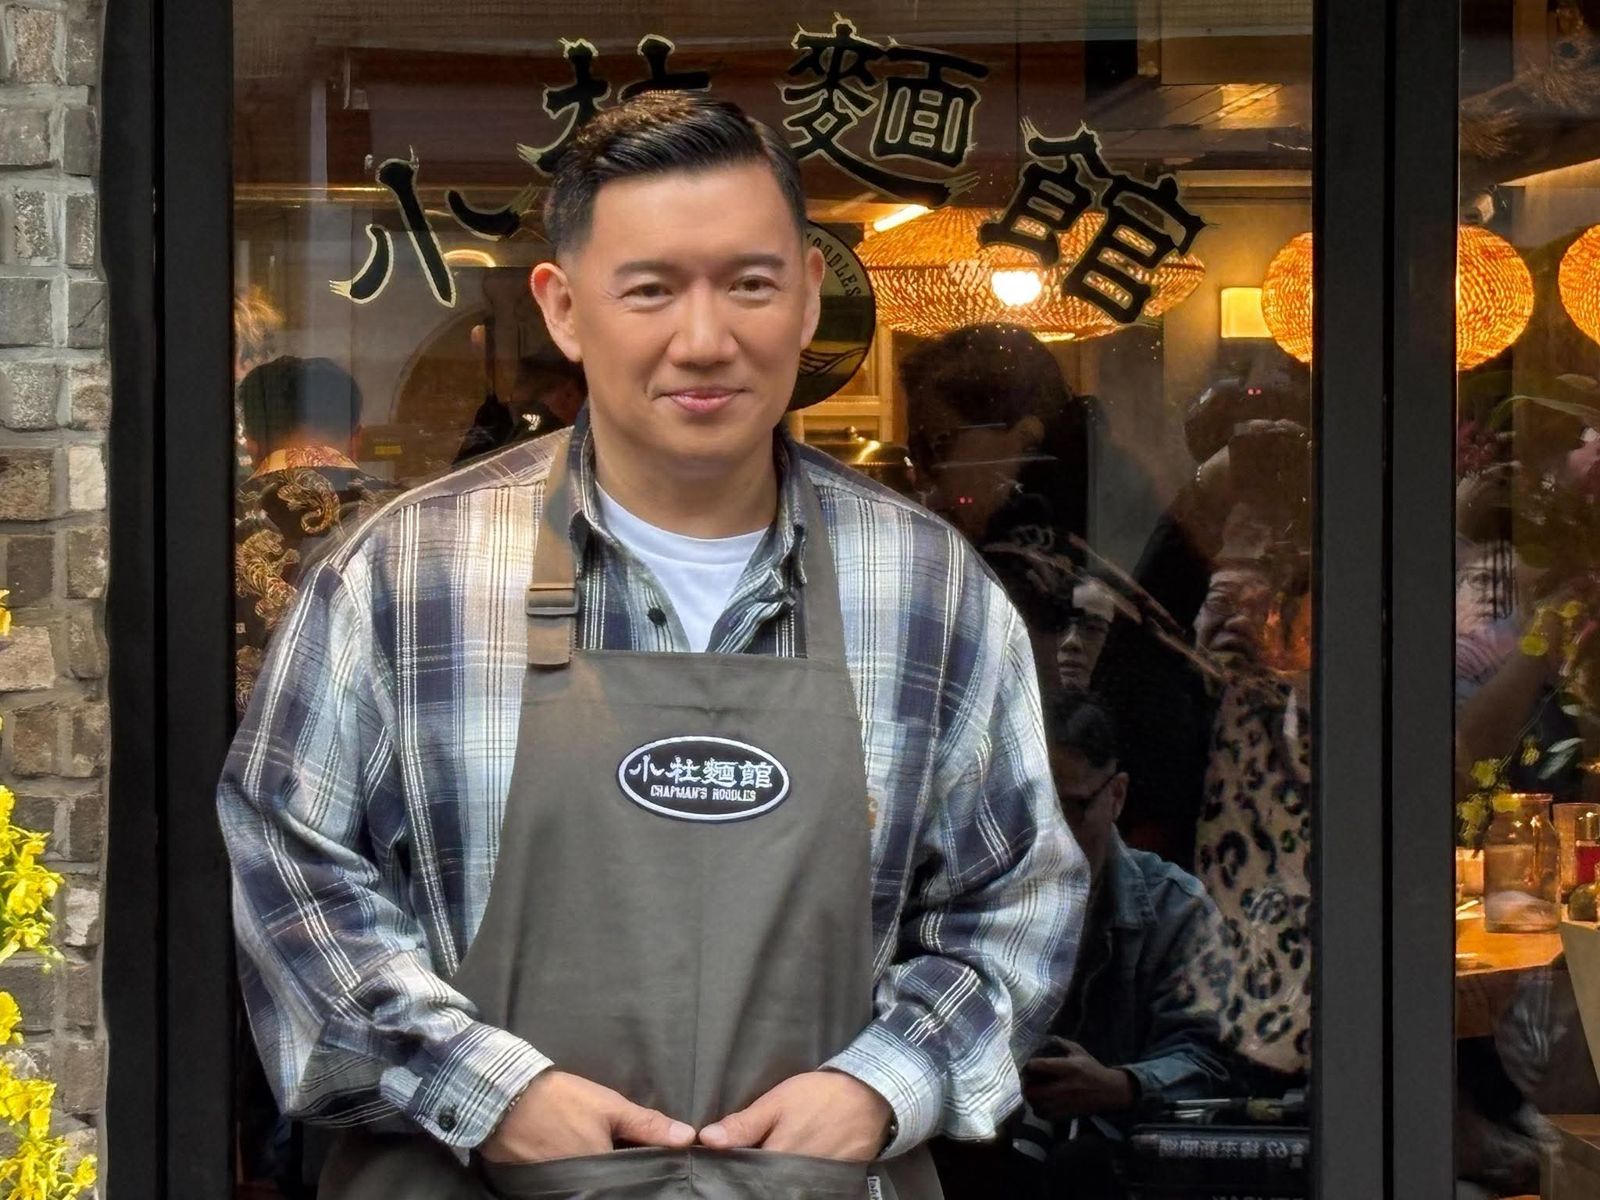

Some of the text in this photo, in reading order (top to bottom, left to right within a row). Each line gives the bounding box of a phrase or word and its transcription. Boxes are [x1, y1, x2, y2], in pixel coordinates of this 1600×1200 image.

[807, 233, 862, 297] OODLES
[628, 753, 774, 788] 小杜麵館
[712, 787, 757, 802] NOODLES
